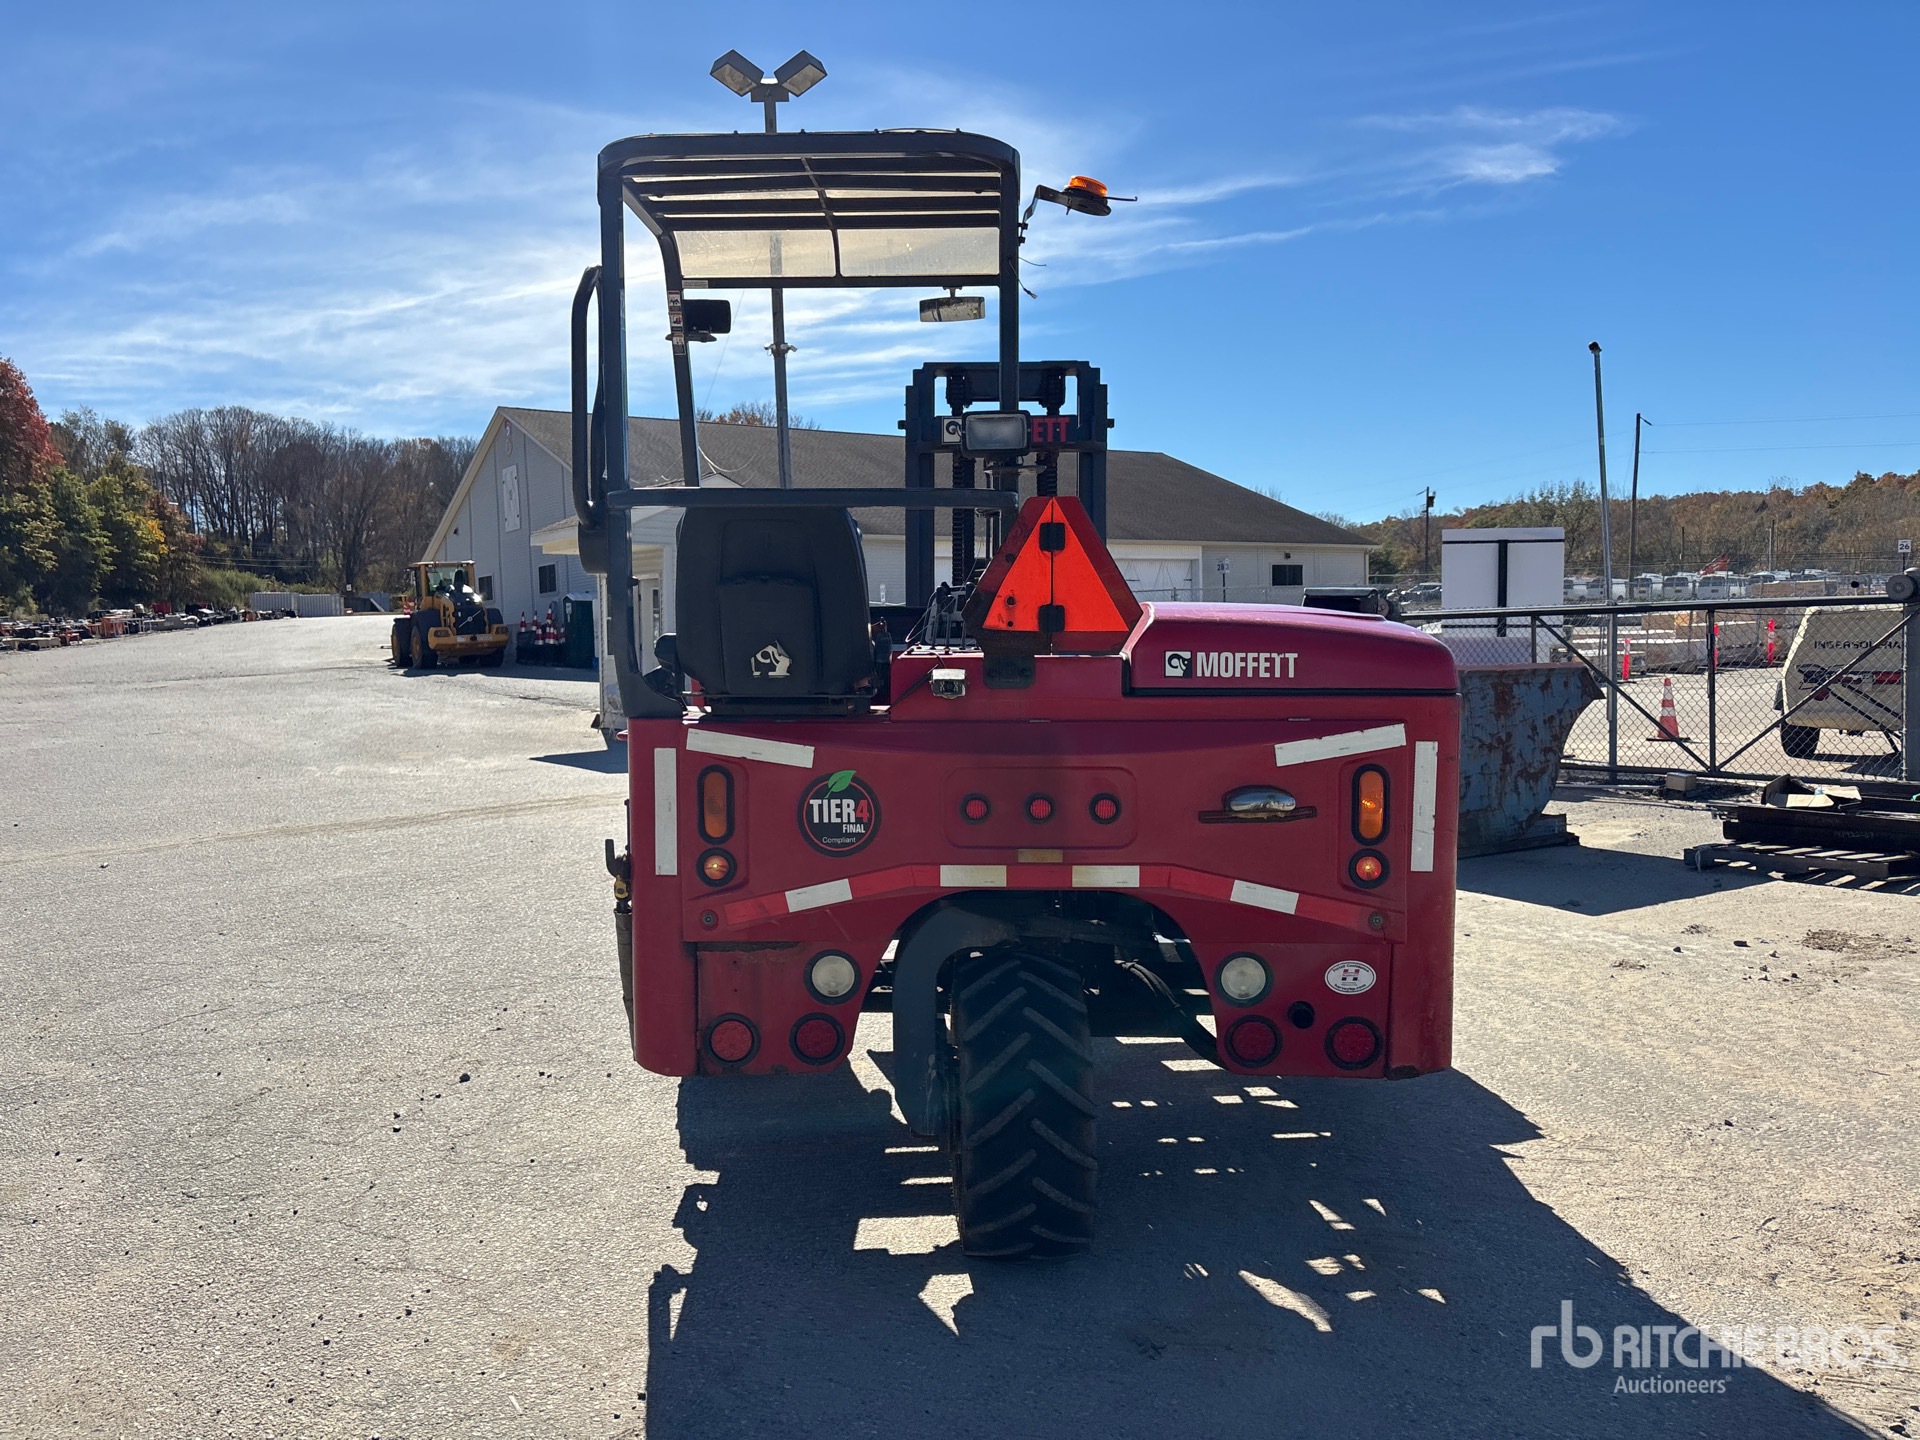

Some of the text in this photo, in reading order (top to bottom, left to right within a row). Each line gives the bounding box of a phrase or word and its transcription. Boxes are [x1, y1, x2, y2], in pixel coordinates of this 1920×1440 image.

[1197, 652, 1298, 678] MOFFETT
[842, 823, 866, 834] FINAL
[822, 836, 856, 845] Compliant
